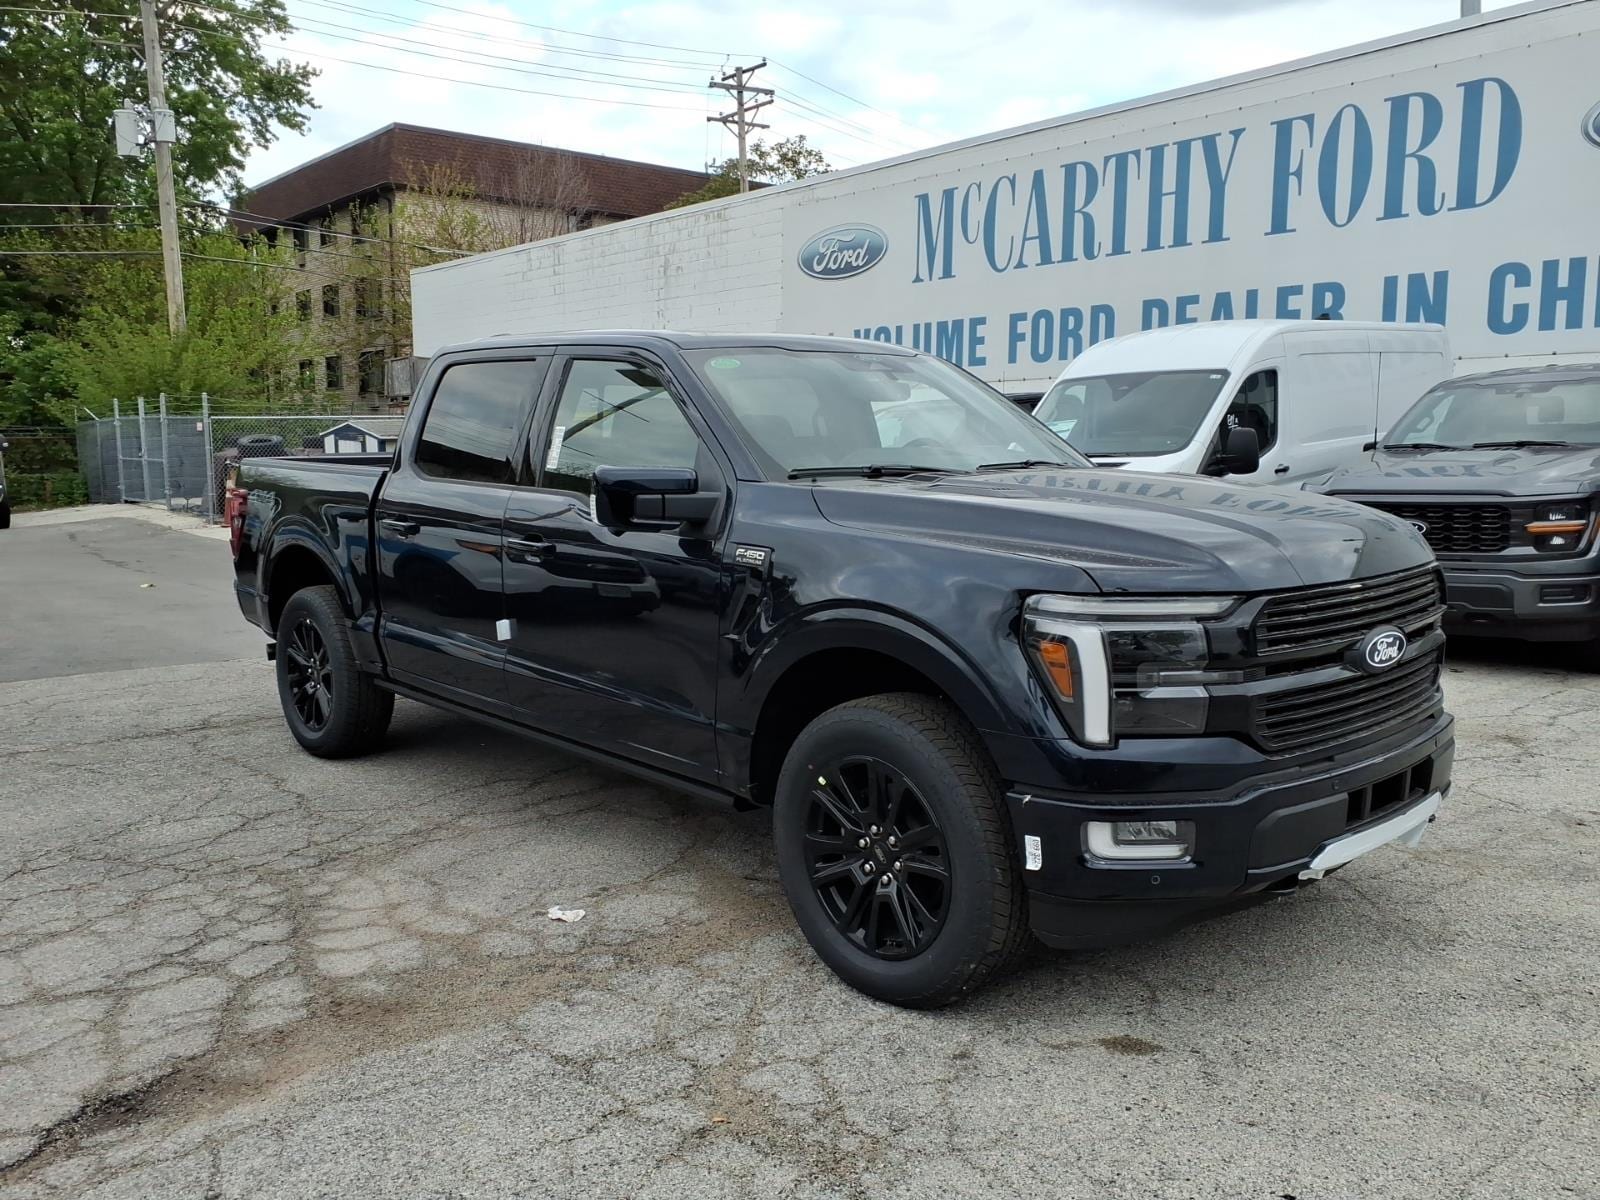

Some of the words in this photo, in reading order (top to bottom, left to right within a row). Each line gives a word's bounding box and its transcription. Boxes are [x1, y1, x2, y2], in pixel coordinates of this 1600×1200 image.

[1264, 77, 1523, 236] FORD
[813, 233, 869, 272] Ford
[1007, 303, 1117, 364] FORD
[1382, 270, 1449, 326] IN
[736, 548, 765, 560] F-150
[1374, 637, 1399, 662] Ford
